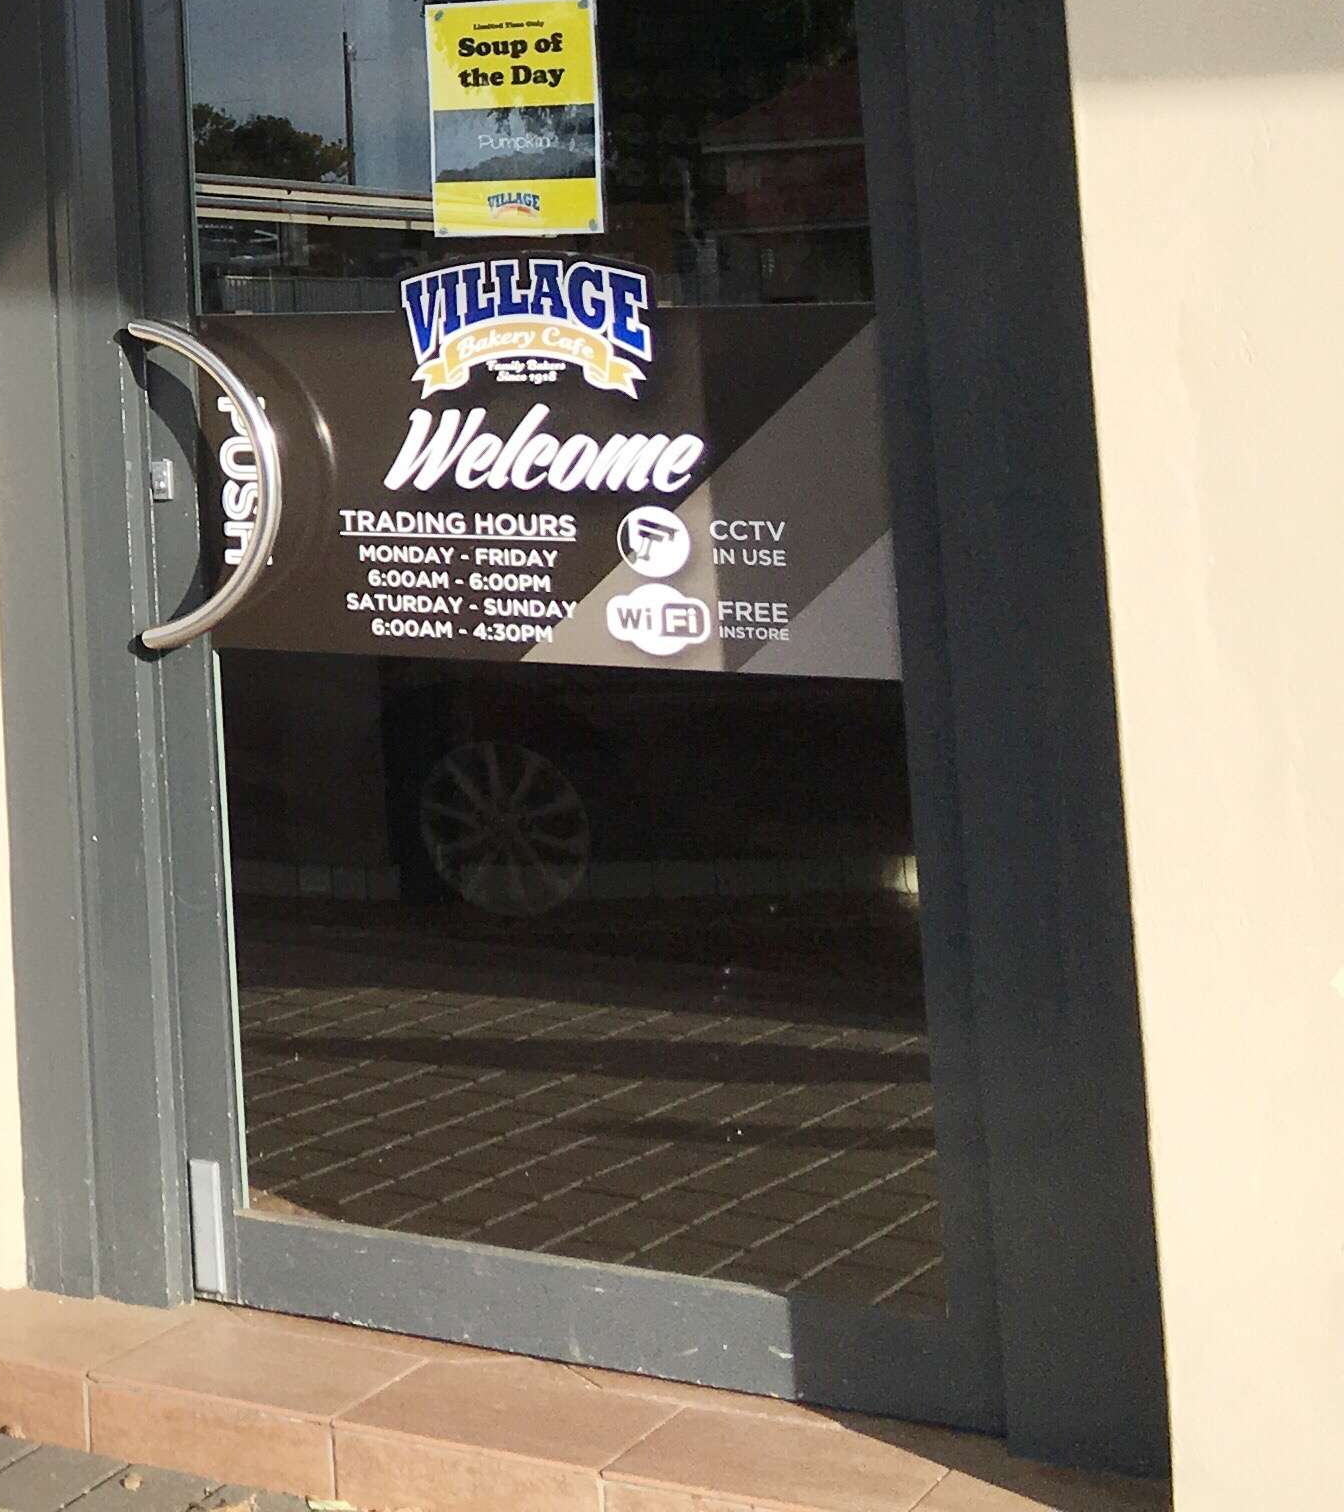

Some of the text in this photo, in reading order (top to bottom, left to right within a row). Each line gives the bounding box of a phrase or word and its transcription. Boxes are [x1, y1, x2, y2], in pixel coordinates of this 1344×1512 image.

[458, 32, 563, 58] Soup of
[458, 65, 565, 88] the Day
[487, 192, 541, 211] VILLAGE
[401, 259, 653, 364] VILLAGE
[457, 326, 596, 360] Bakery Cafe
[486, 360, 567, 373] Family Bakers
[496, 372, 558, 384] Since 1918
[384, 402, 707, 492] Welcome
[339, 510, 577, 537] TRADING HOURS
[710, 520, 786, 542] CCTV
[358, 544, 454, 565] MONDAY
[475, 548, 558, 568] FRIDAY
[713, 548, 787, 567] IN USE
[368, 569, 450, 589] 6:00AM
[469, 573, 551, 593] 6:00PM
[346, 593, 463, 615] SATURDAY
[483, 598, 577, 619] SUNDAY
[717, 600, 789, 623] FREE
[371, 618, 453, 639] 6:00AM
[472, 622, 553, 643] 4:30PM
[719, 625, 791, 641] INSTORE
